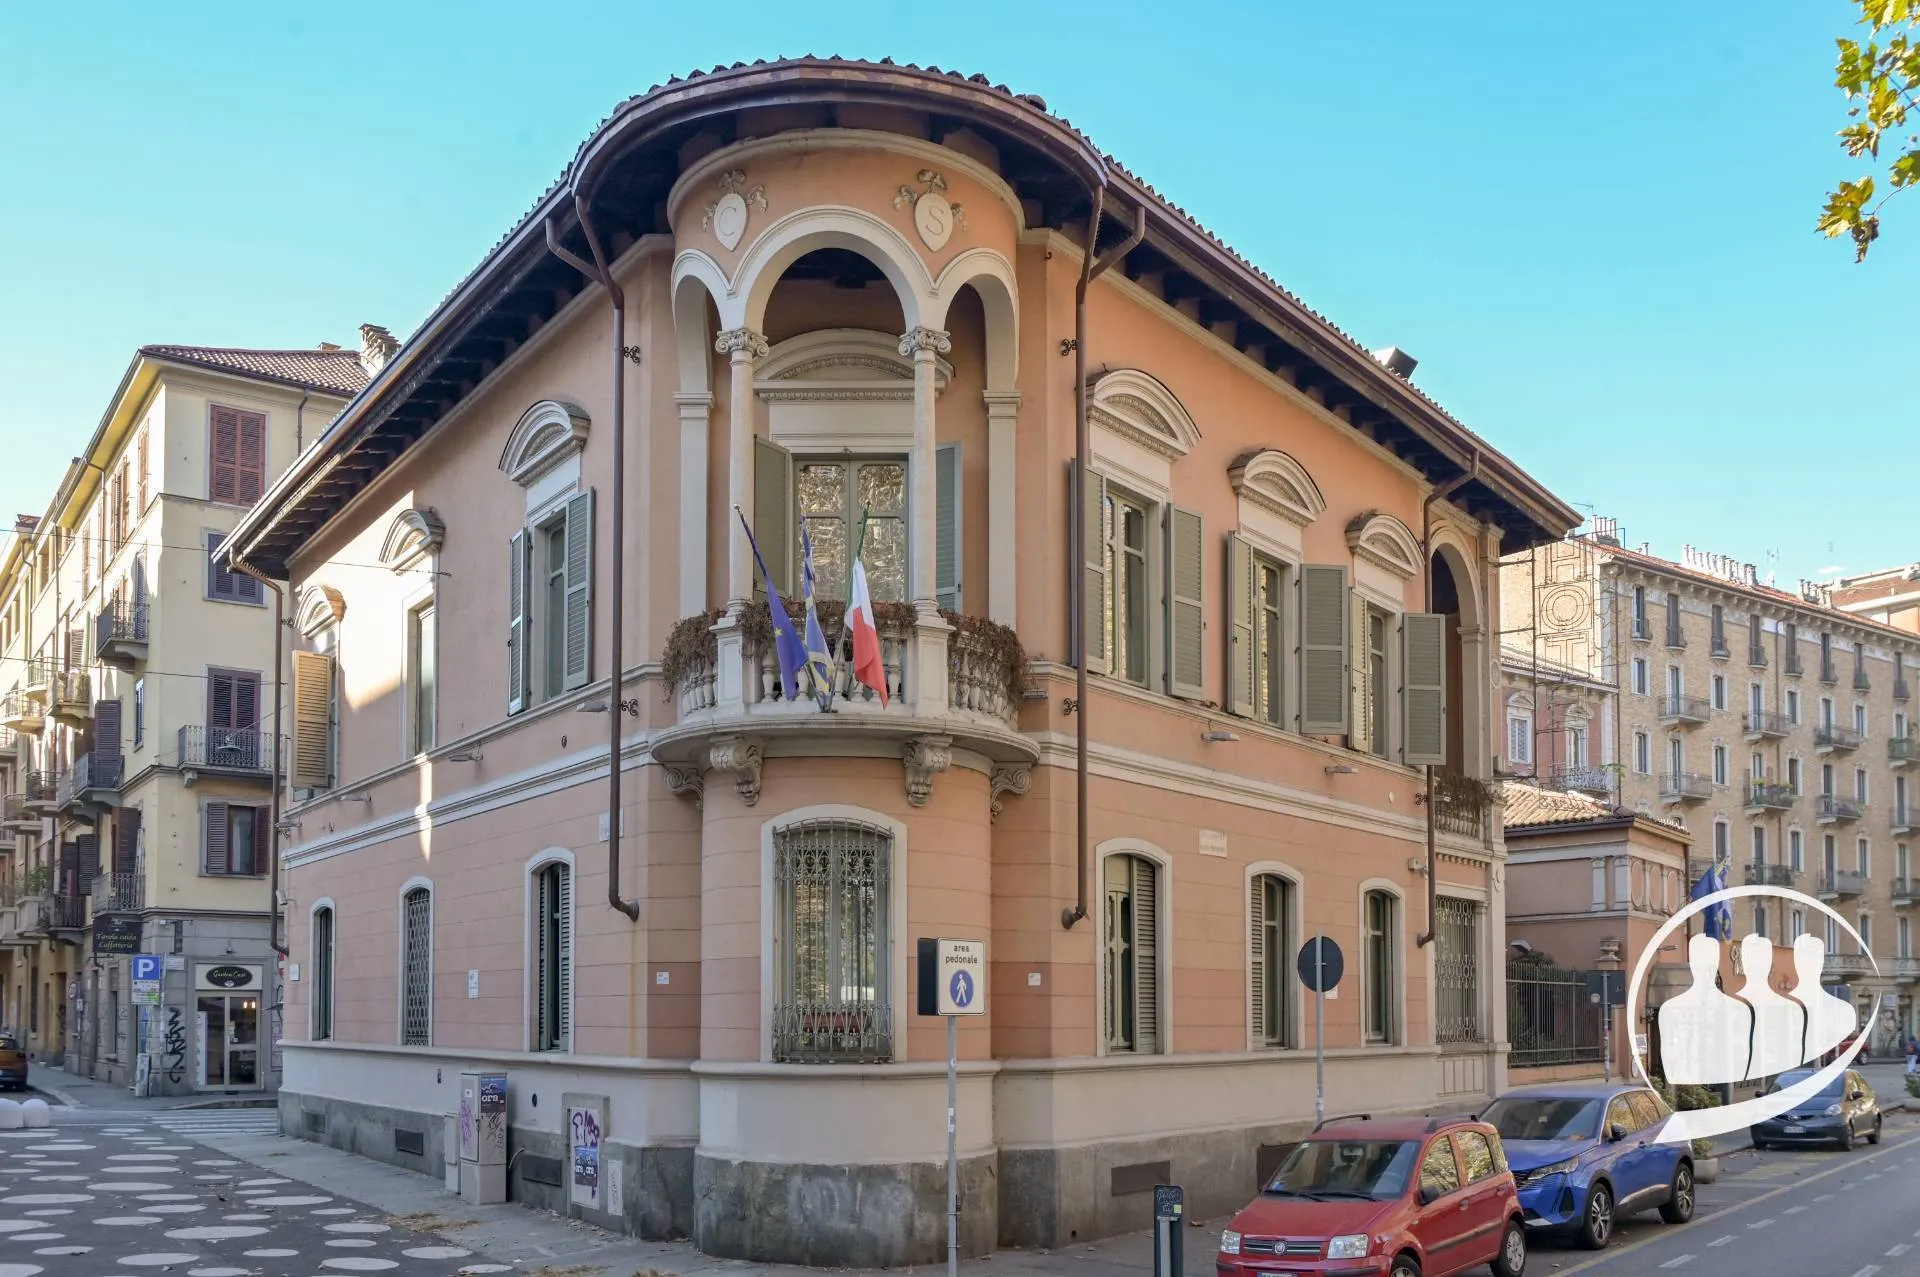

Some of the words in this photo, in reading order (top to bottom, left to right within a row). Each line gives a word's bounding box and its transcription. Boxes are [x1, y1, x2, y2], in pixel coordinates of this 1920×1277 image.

[718, 206, 737, 237] C
[926, 206, 945, 236] S
[138, 958, 155, 978] P
[945, 954, 978, 964] pedonale
